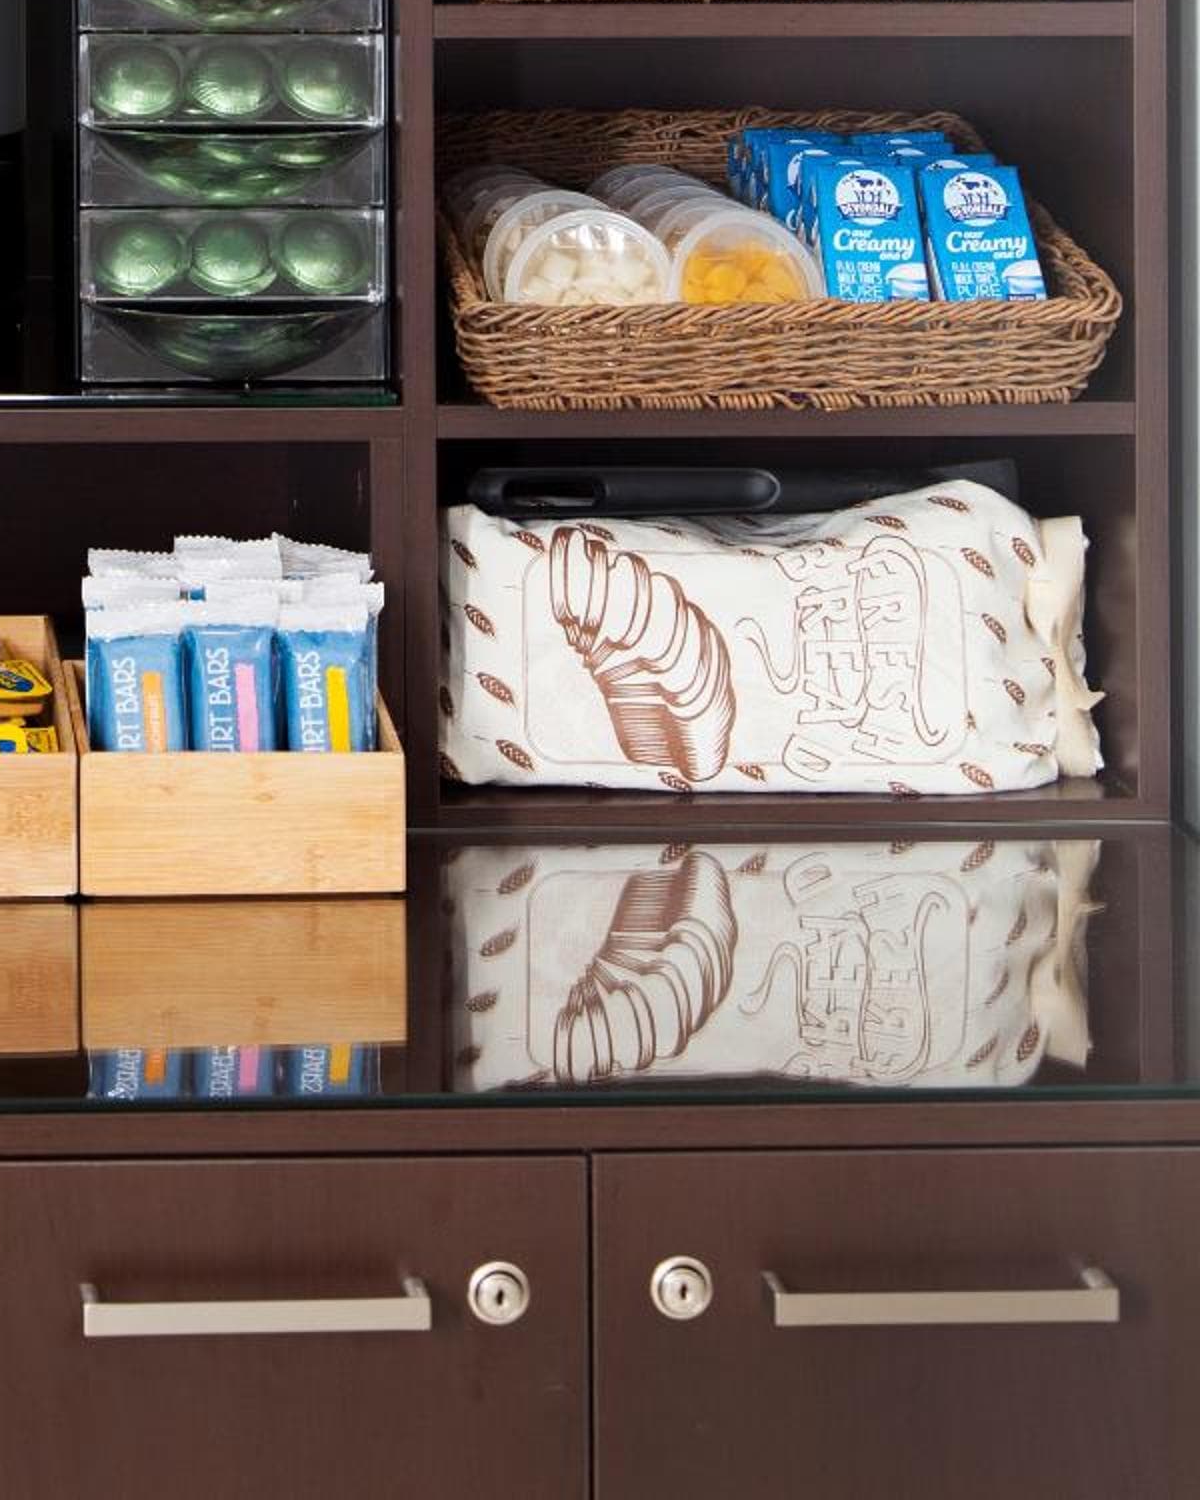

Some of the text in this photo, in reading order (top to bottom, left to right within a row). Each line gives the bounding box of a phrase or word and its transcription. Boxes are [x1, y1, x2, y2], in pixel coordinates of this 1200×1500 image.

[833, 228, 915, 261] Creamy
[946, 231, 1028, 260] Creamy
[957, 284, 1003, 299] PURE
[113, 656, 140, 715] BARS
[206, 647, 232, 705] BARS
[297, 651, 323, 708] BARS
